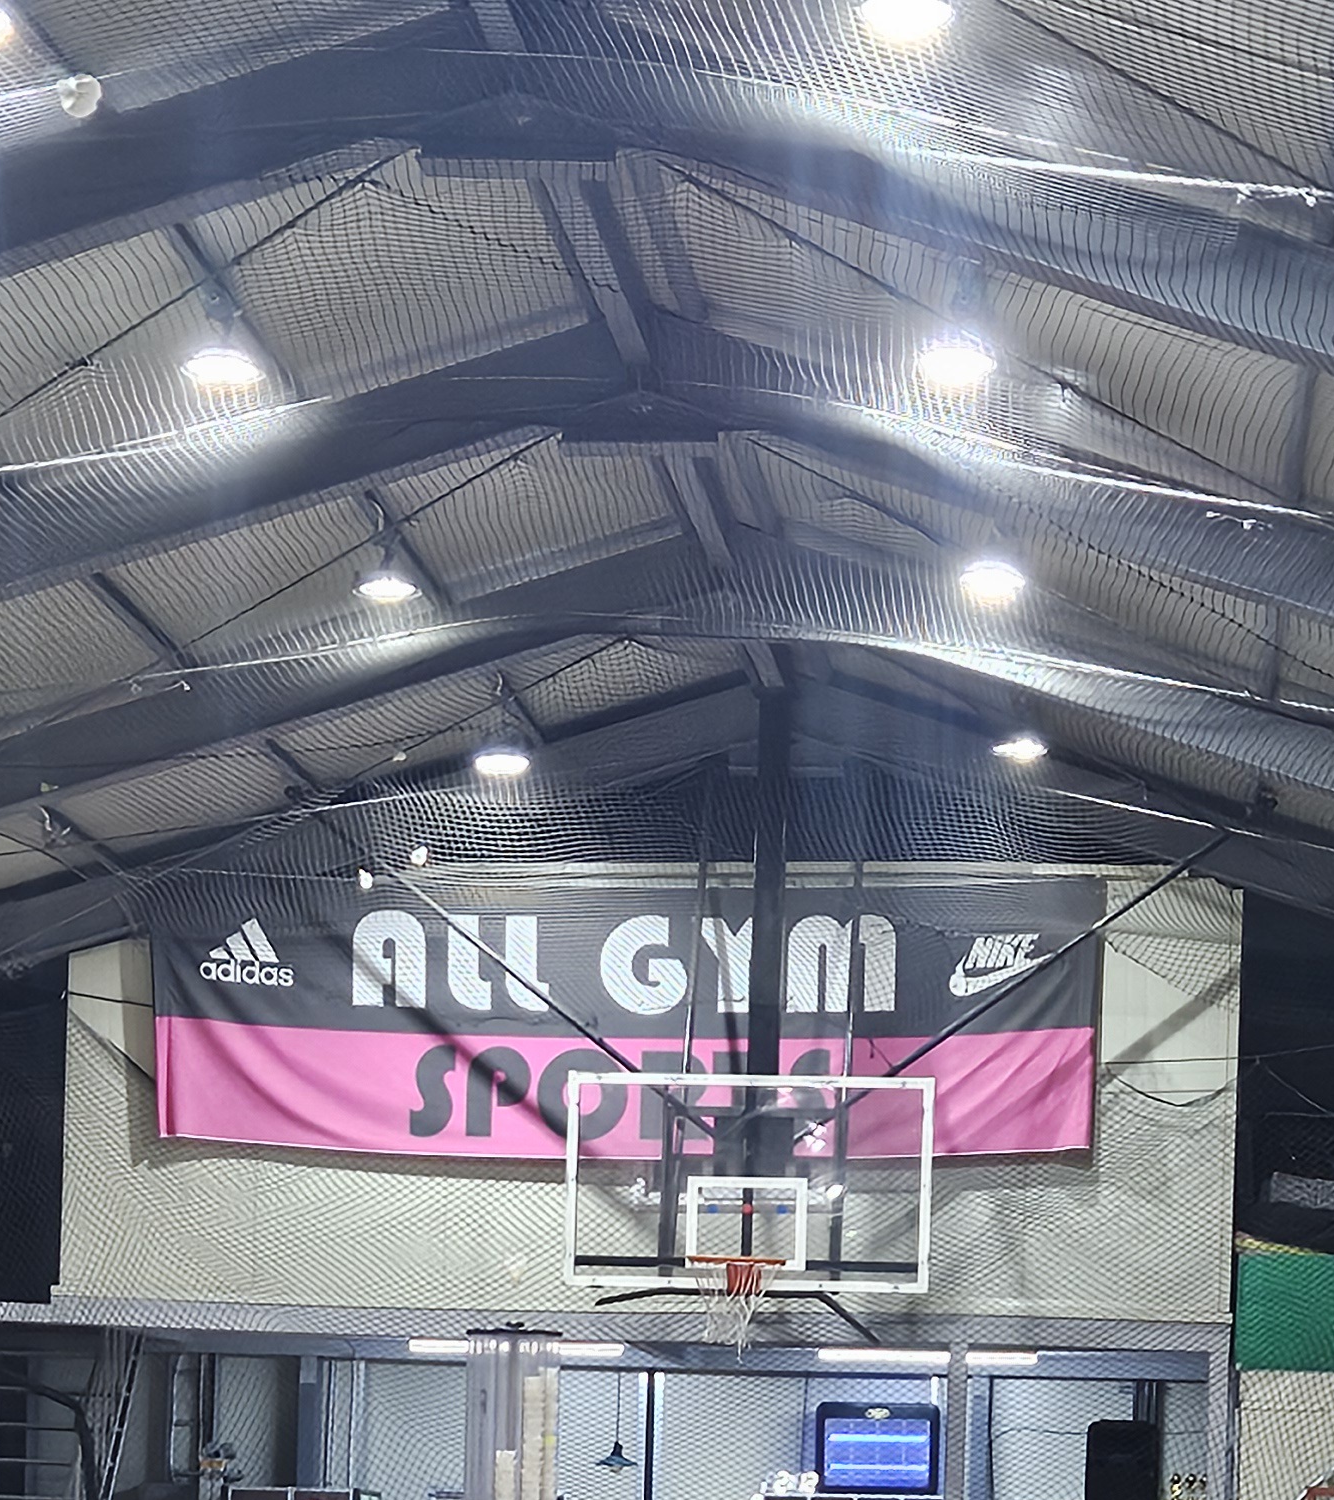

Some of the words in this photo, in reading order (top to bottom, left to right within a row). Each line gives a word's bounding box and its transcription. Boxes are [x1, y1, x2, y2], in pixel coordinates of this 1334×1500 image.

[352, 909, 550, 1012] ALL
[600, 914, 897, 1015] GYM
[964, 932, 1041, 970] NIKE
[199, 959, 295, 987] adidas
